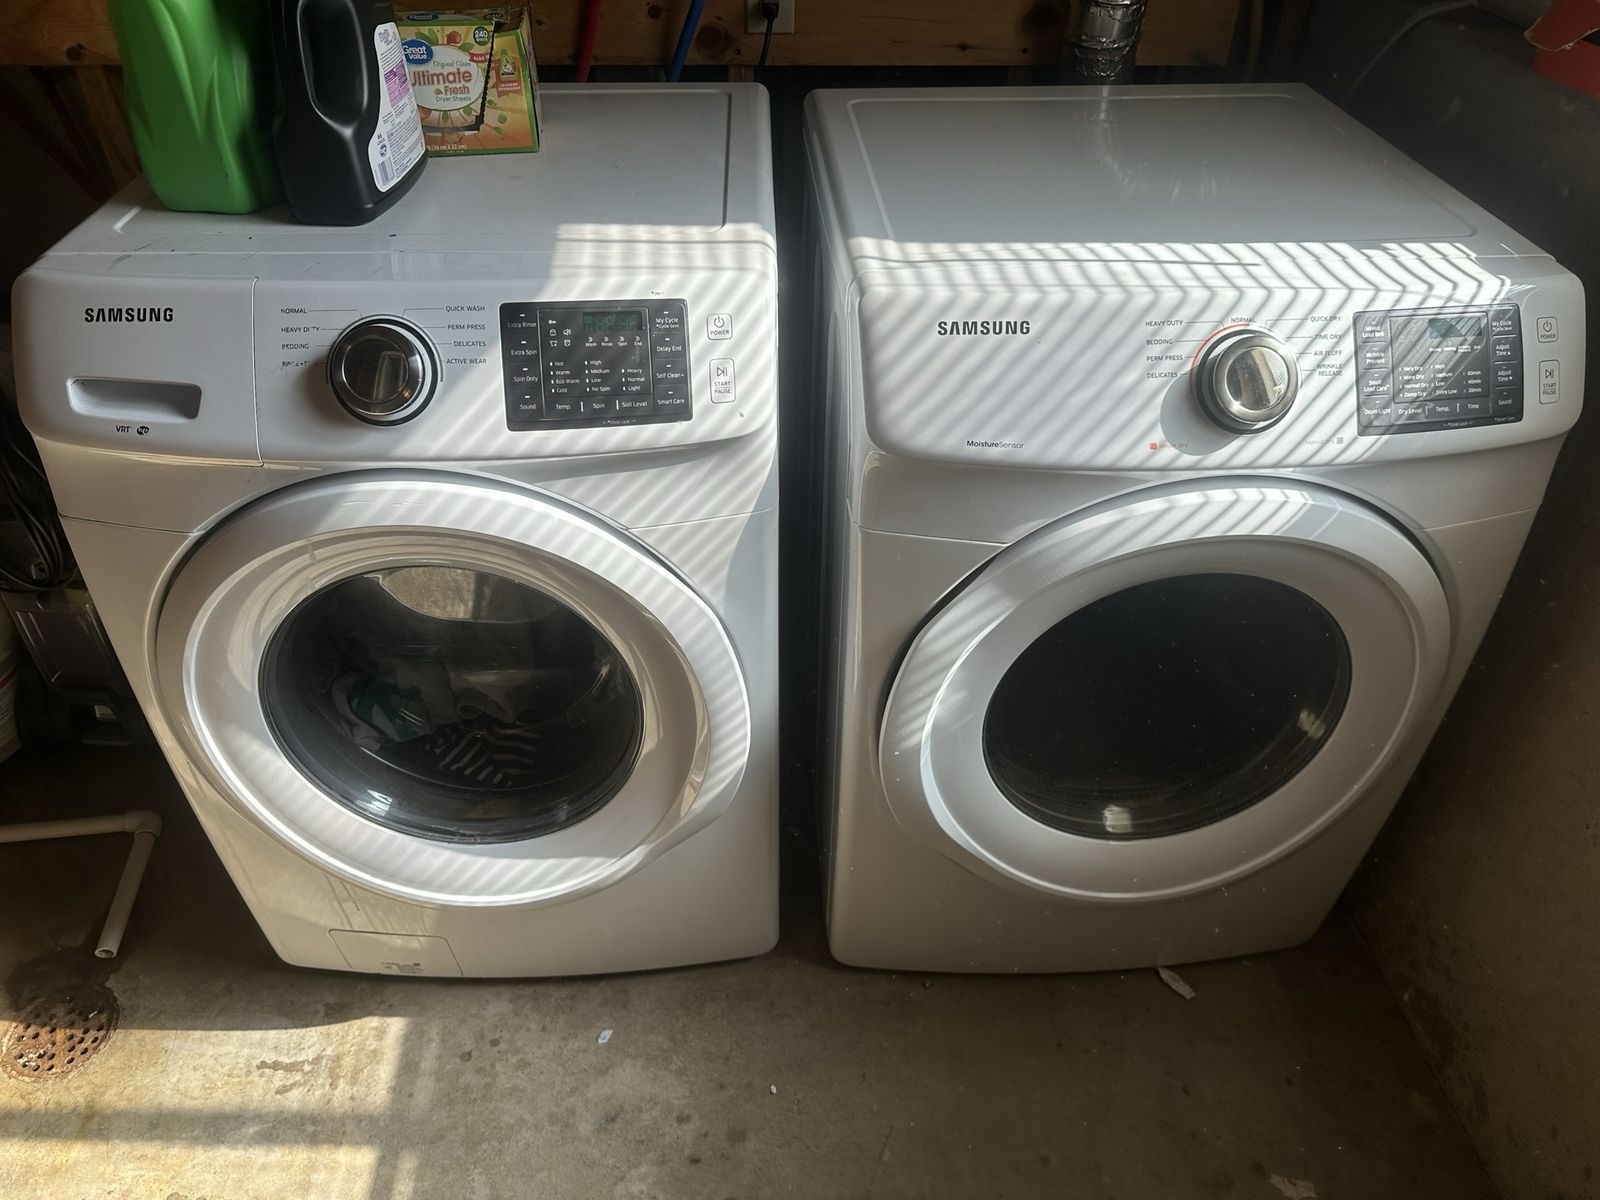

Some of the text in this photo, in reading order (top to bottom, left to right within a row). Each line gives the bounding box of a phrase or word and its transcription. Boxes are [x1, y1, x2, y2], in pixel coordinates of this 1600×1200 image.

[403, 46, 427, 54] Great
[433, 60, 454, 69] Original
[409, 68, 472, 86] Ultimate
[444, 84, 470, 94] Fresh
[84, 308, 174, 322] SAMSUNG
[938, 320, 1030, 335] SAMSUNG
[967, 440, 1024, 449] MoistureSensor
